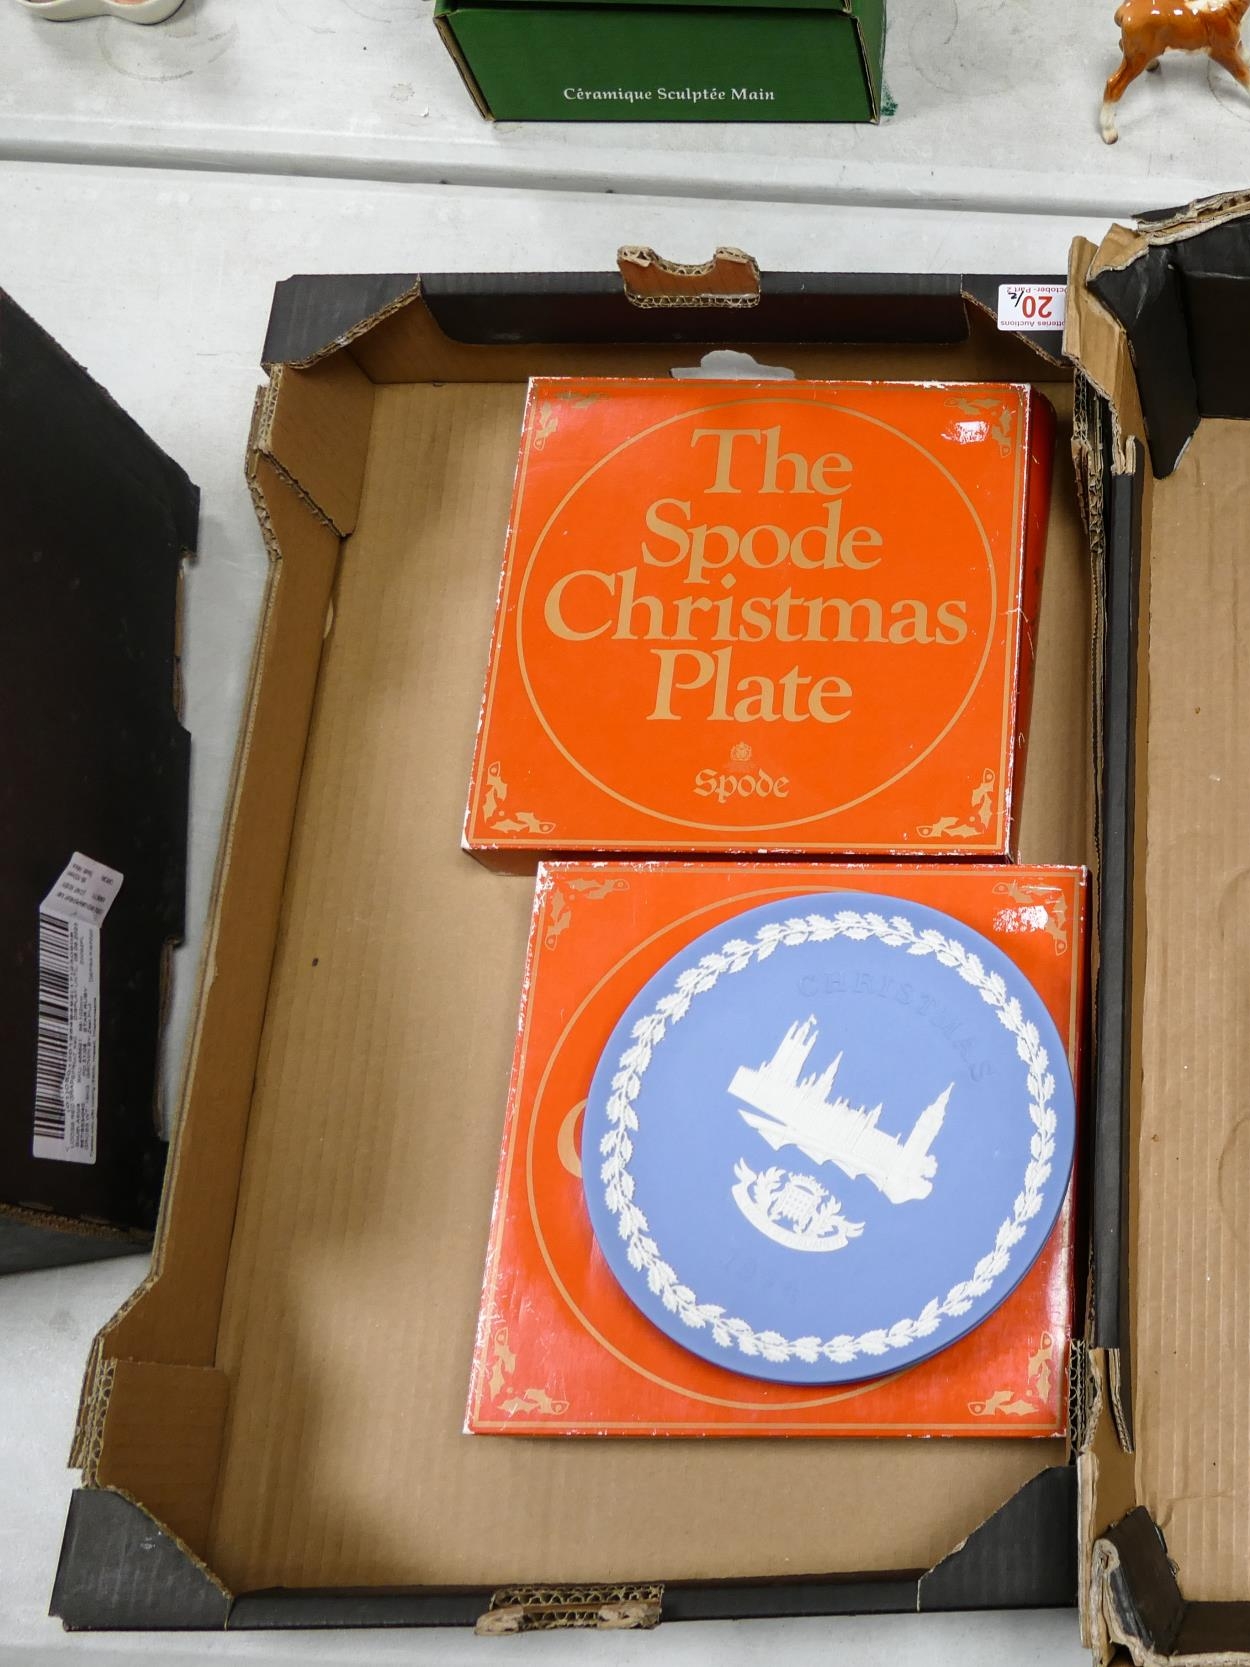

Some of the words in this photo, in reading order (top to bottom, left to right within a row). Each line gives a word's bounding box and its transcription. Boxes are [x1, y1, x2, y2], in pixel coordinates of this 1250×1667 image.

[563, 87, 653, 104] Céramique
[657, 87, 727, 104] Sculptée
[730, 87, 776, 101] Main
[1000, 320, 1035, 328] Auctions
[1022, 295, 1053, 319] 20
[1037, 320, 1065, 328] otteries
[690, 425, 854, 496] The
[640, 498, 884, 585] Spode
[544, 565, 968, 646] Christmas
[646, 646, 853, 724] Plate
[693, 767, 791, 805] Spode
[797, 971, 997, 1083] CHRISTMAS
